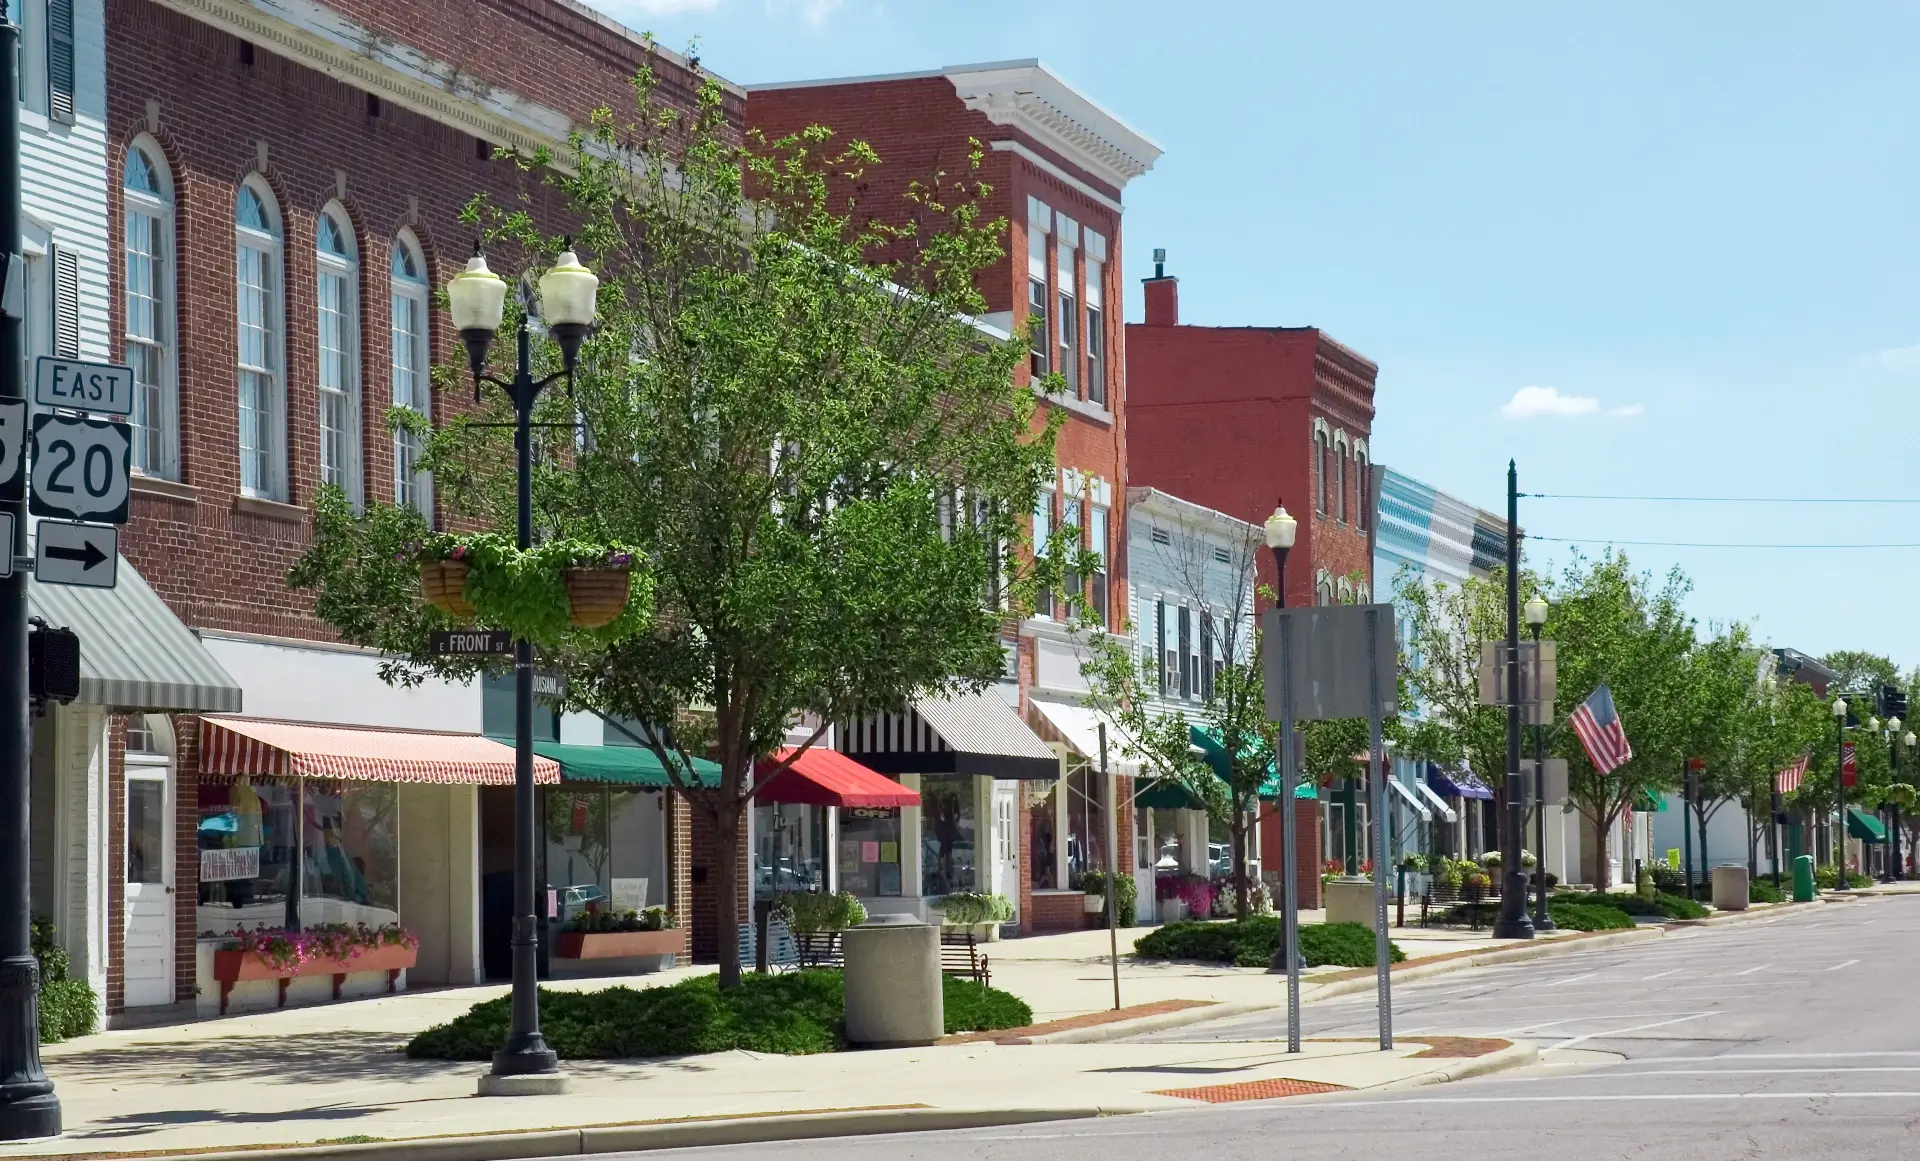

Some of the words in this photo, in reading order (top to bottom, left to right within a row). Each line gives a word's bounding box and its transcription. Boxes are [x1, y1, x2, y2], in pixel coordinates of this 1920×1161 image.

[52, 364, 119, 403] EAST
[46, 439, 113, 498] 20
[439, 642, 445, 651] E
[449, 634, 491, 652] FRONT
[495, 642, 504, 651] ST
[532, 675, 556, 694] OUISIANA
[854, 809, 890, 819] OFF
